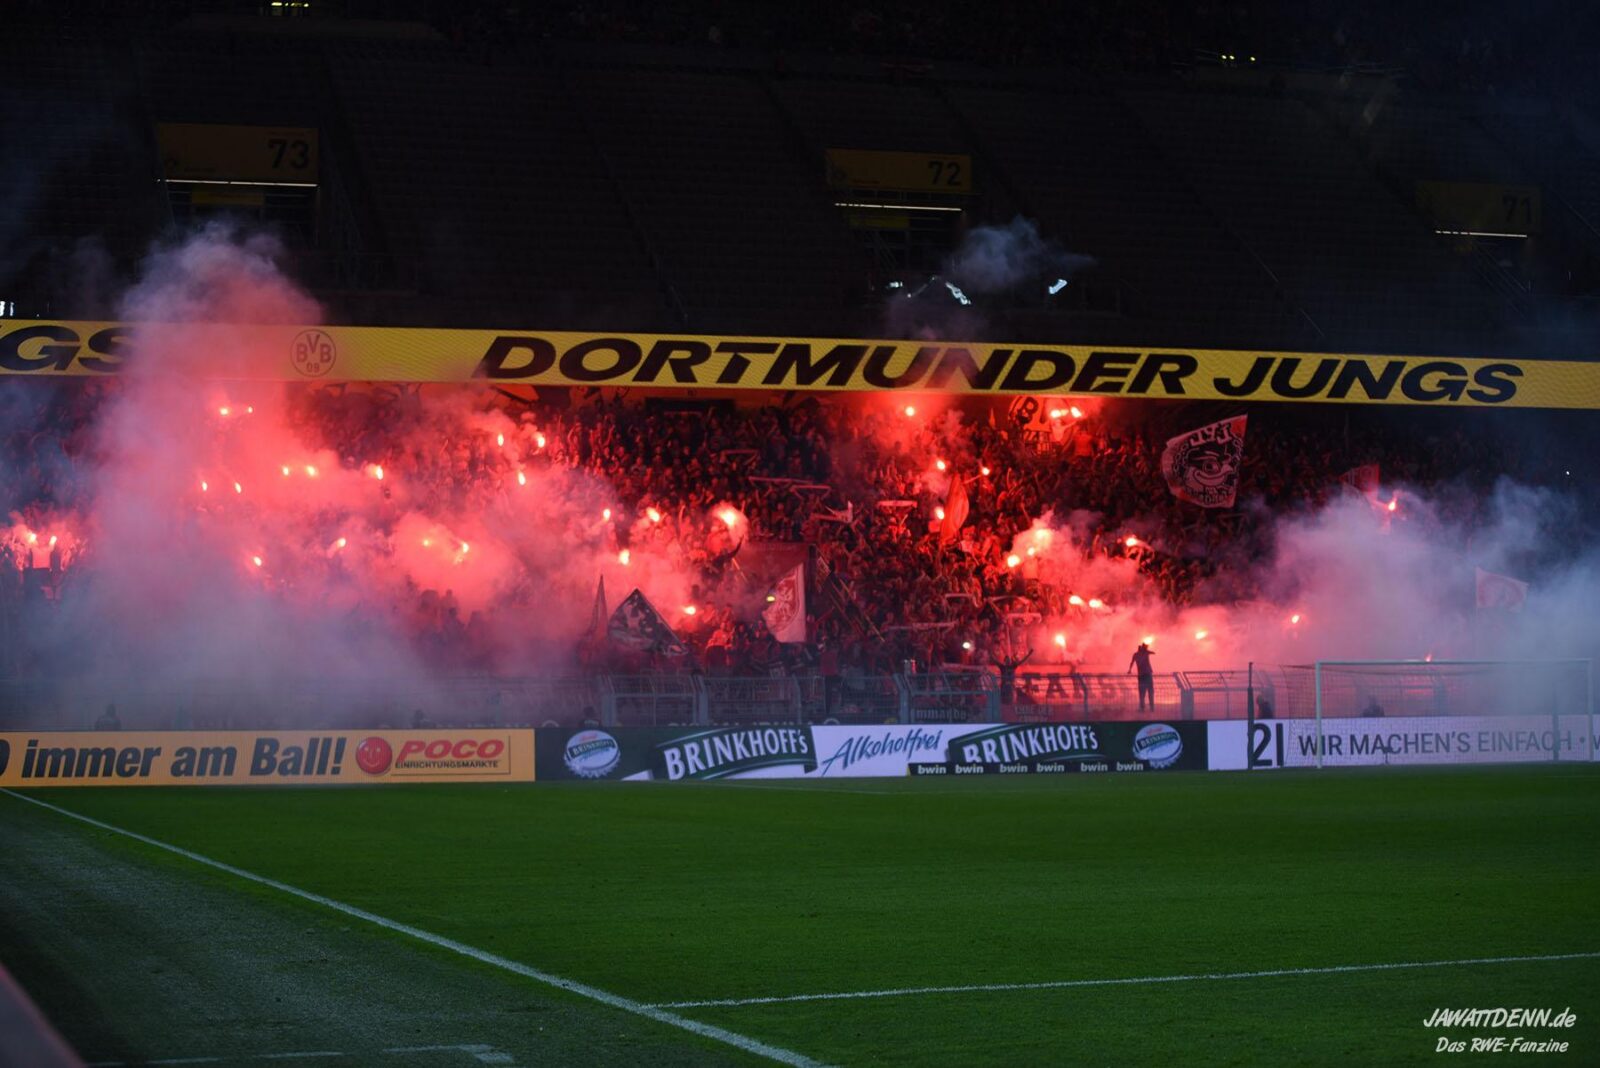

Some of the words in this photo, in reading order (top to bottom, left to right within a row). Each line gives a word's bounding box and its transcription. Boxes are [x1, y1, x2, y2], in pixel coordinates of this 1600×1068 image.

[268, 138, 309, 169] 73
[929, 161, 961, 186] 72
[1503, 193, 1532, 224] 71
[295, 334, 333, 363] BVB
[471, 335, 1199, 396] DORTMUNDER
[1213, 356, 1525, 404] JUNGS
[21, 739, 162, 778] immer
[170, 746, 237, 777] am
[249, 736, 348, 777] Ball!
[396, 739, 505, 764] POCO
[820, 727, 942, 777] Alkoholfrei
[1298, 734, 1343, 756] WIR
[1349, 731, 1471, 756] MACHEN'S
[1478, 730, 1572, 753] EINFACH
[917, 765, 947, 775] bwin
[955, 763, 984, 774] bwin
[1000, 763, 1028, 773] bwin
[1036, 762, 1065, 773] bwin
[1081, 761, 1108, 772] bwin
[1116, 761, 1144, 772] bwin
